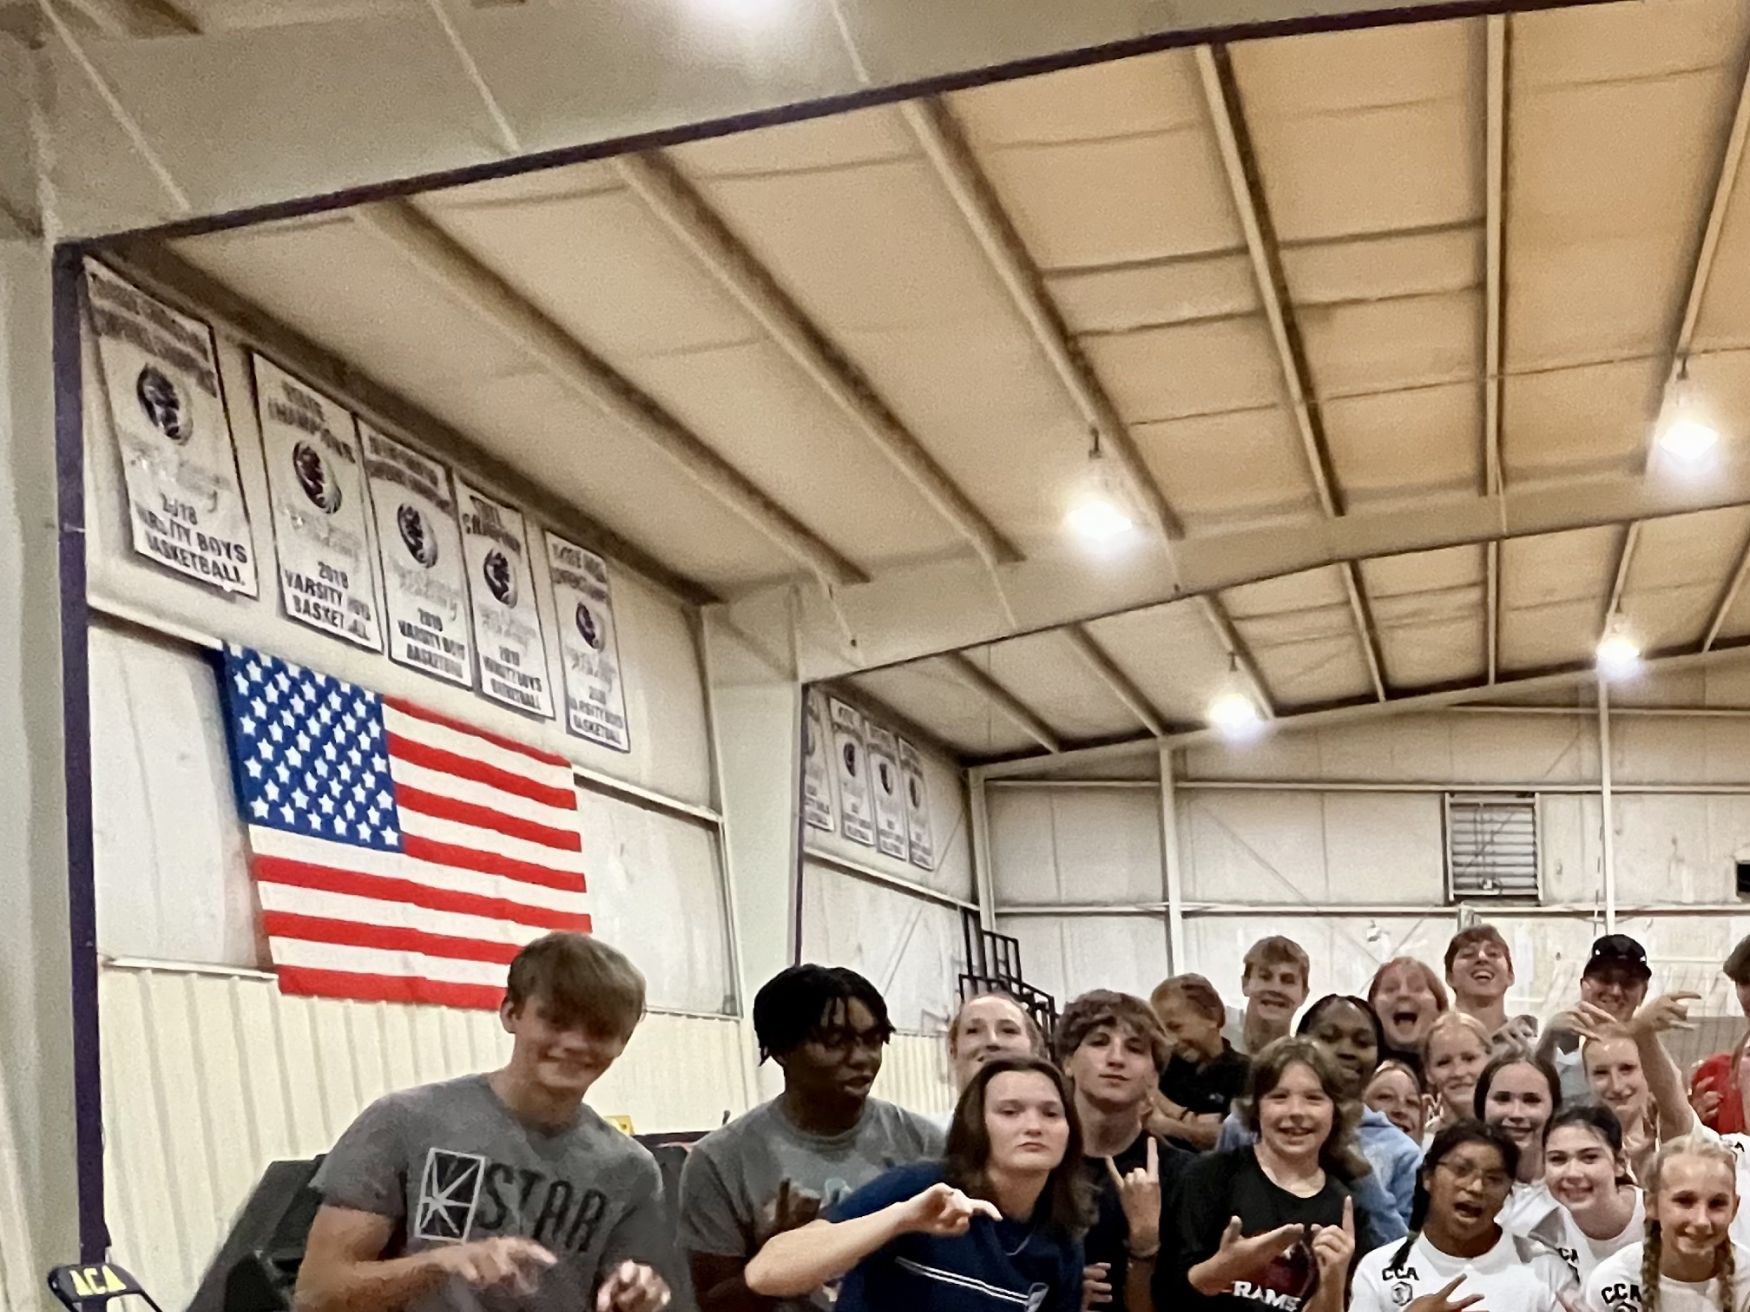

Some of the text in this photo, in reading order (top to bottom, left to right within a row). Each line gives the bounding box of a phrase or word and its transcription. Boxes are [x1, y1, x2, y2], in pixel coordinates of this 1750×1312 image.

[197, 531, 248, 564] BOYS
[284, 569, 343, 607] VARSITY
[69, 1264, 127, 1297] ACA
[1232, 1280, 1302, 1312] RAMS
[1601, 1283, 1642, 1305] CCA
